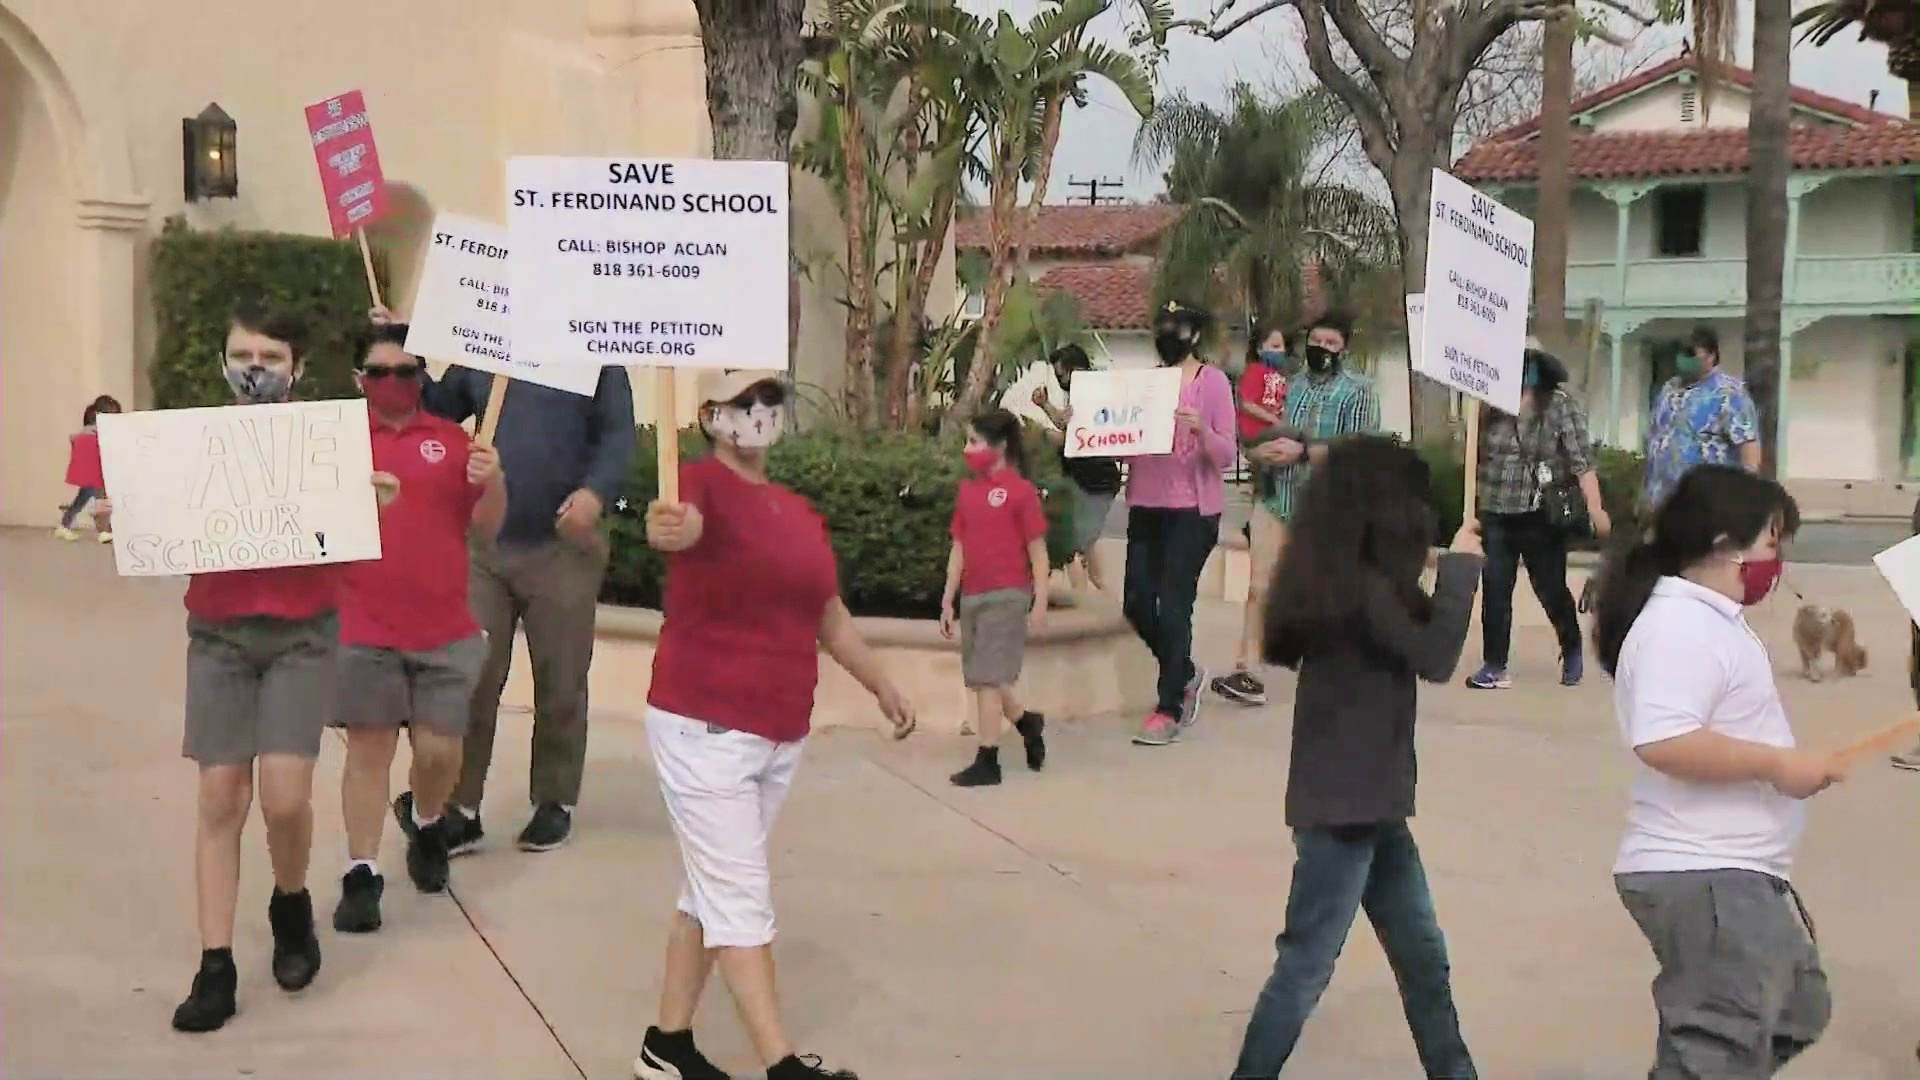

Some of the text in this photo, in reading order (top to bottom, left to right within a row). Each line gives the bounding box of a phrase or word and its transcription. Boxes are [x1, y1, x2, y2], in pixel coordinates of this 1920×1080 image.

[608, 163, 675, 184] SAVE
[514, 189, 778, 214] ST. FERDINAND SCHOOL
[1471, 193, 1496, 225] SAVE
[434, 231, 456, 249] ST.
[1435, 201, 1529, 268] ST. FERDINAND SCHOOL
[557, 239, 728, 256] CALL: BISHOP ACLAN
[592, 263, 700, 279] 818 361-6009
[459, 277, 491, 292] CALL:
[477, 298, 498, 312] 818
[451, 325, 480, 341] SIGN
[483, 331, 504, 346] THE
[568, 320, 723, 337] SIGN THE PETITION
[587, 340, 696, 356] CHANGE.ORG
[1473, 358, 1500, 382] PETITION
[1092, 405, 1143, 427] OUR
[1074, 426, 1144, 451] SCHOOL!
[204, 502, 304, 543] OUR
[126, 531, 328, 574] SCHOOL!
